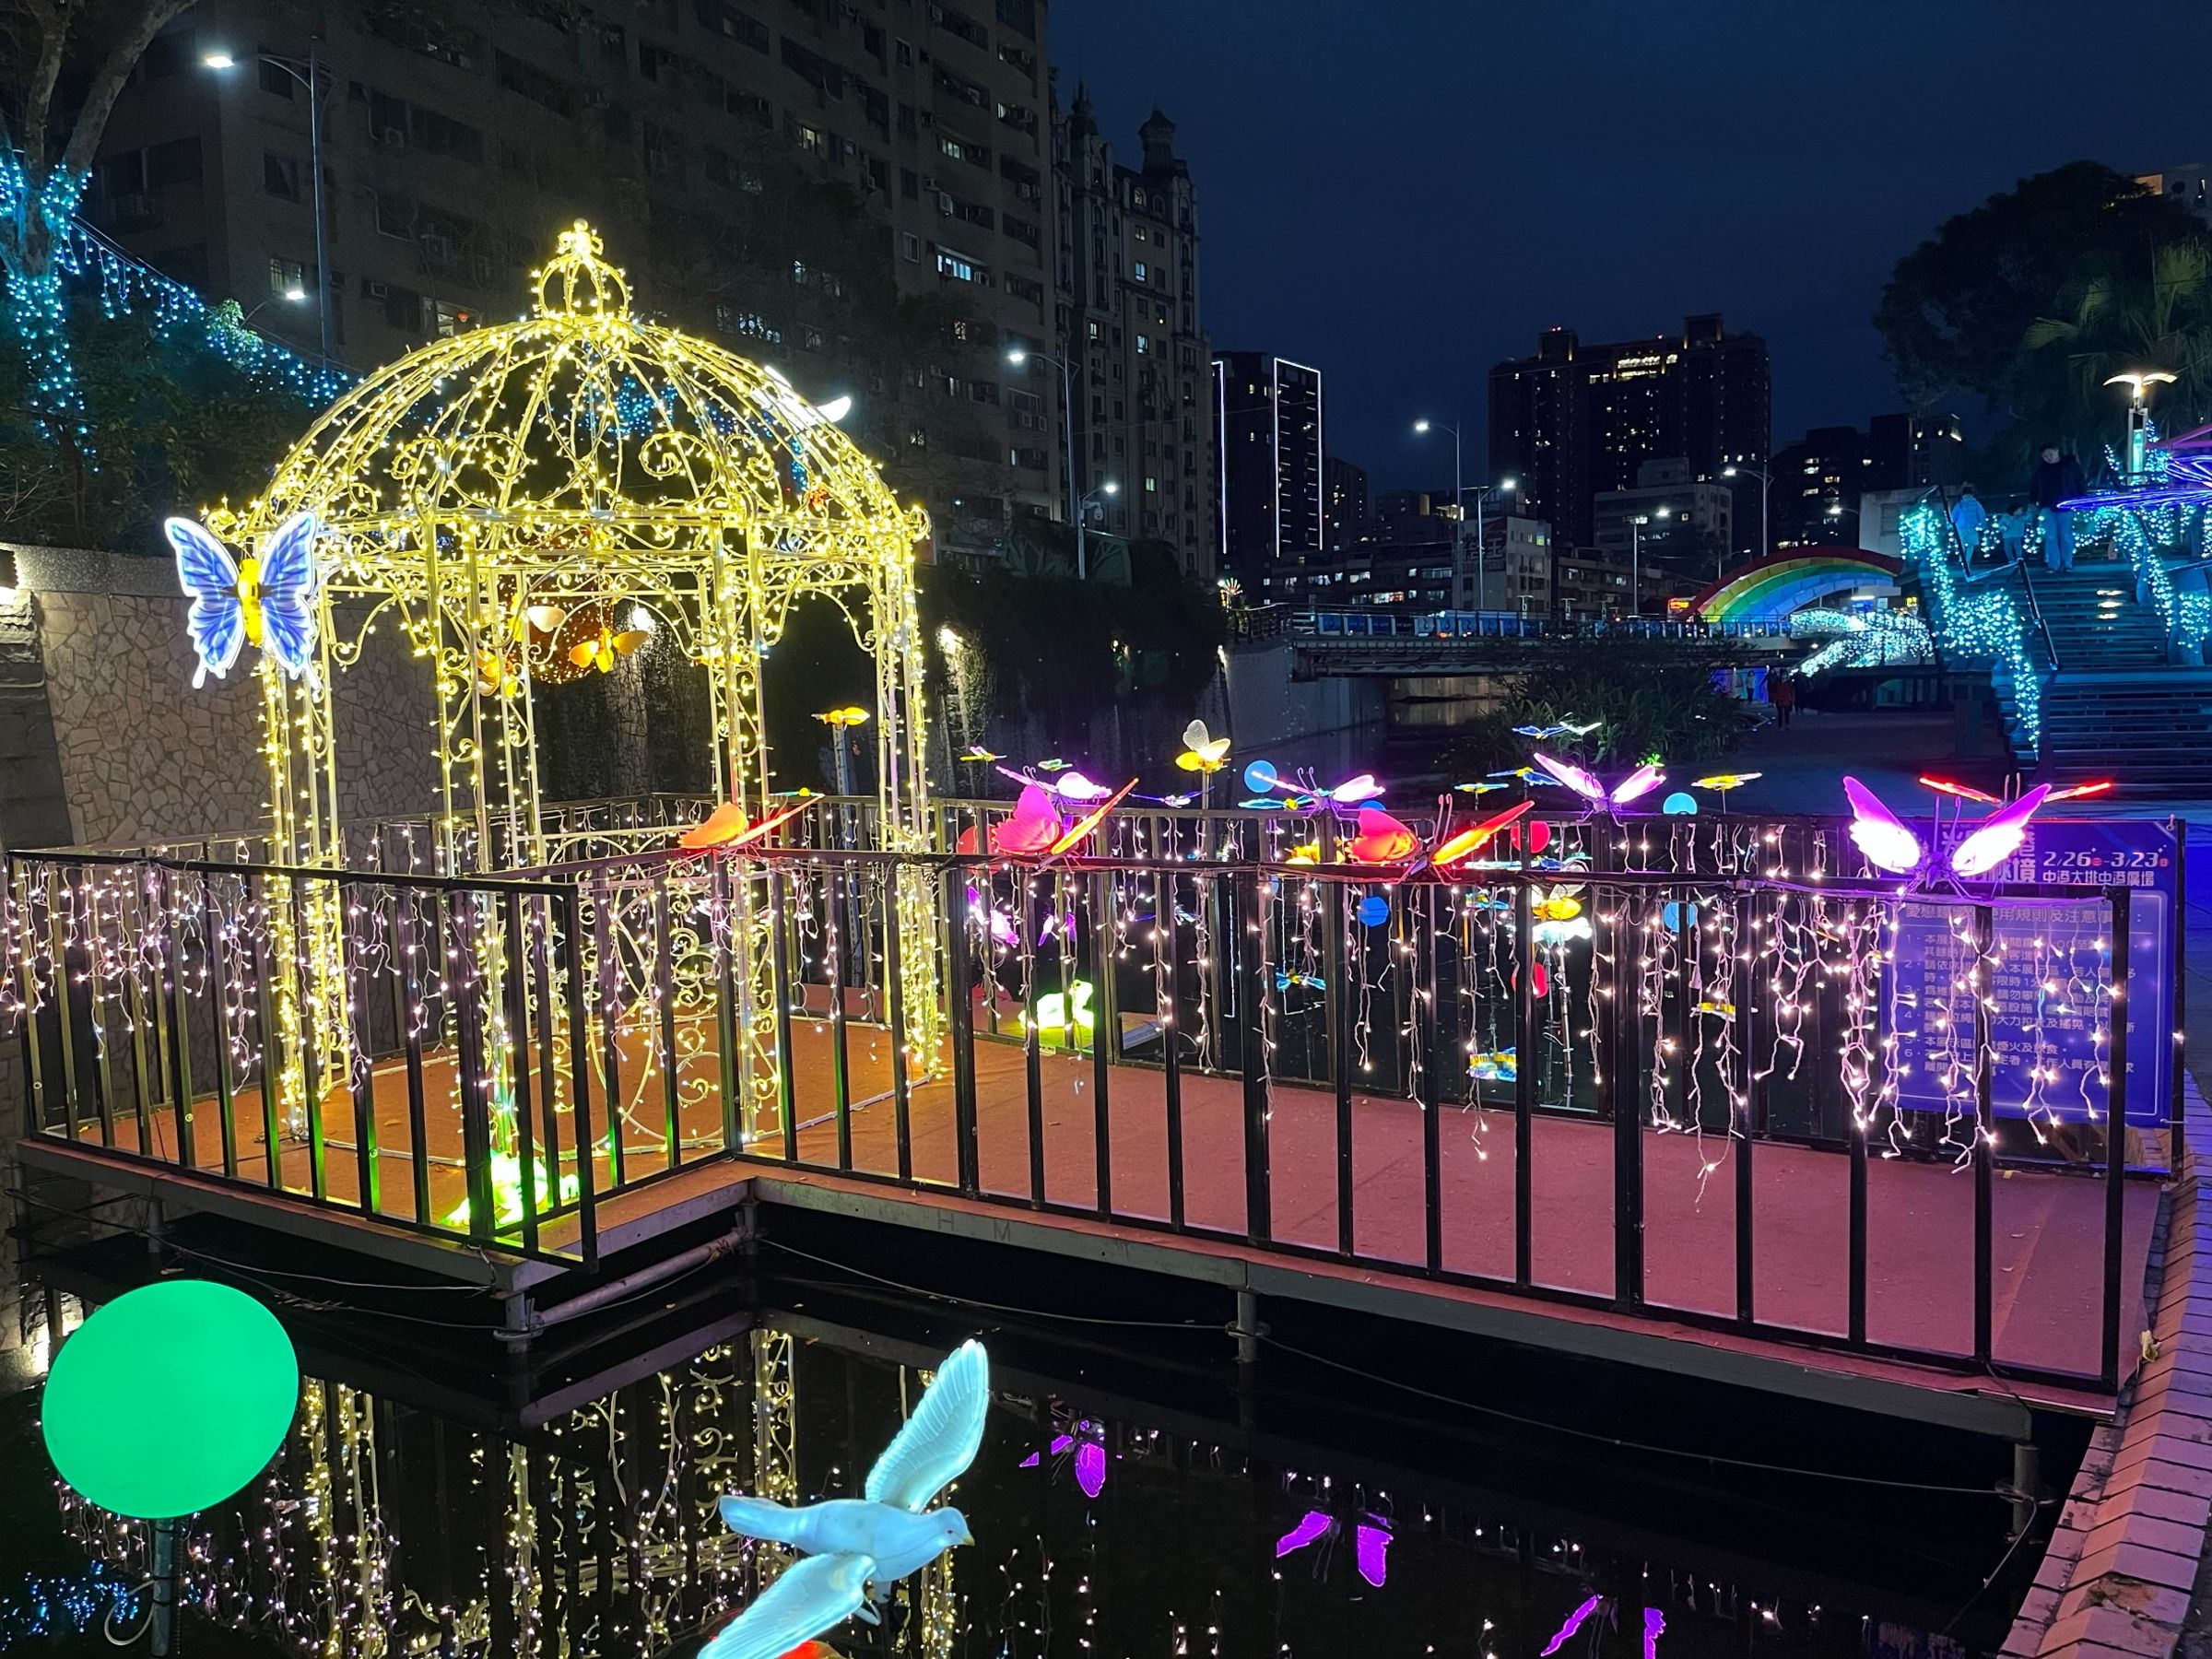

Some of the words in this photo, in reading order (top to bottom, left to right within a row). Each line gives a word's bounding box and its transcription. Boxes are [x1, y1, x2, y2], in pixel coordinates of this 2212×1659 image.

[2042, 870, 2155, 887] 中港大排中港廣場
